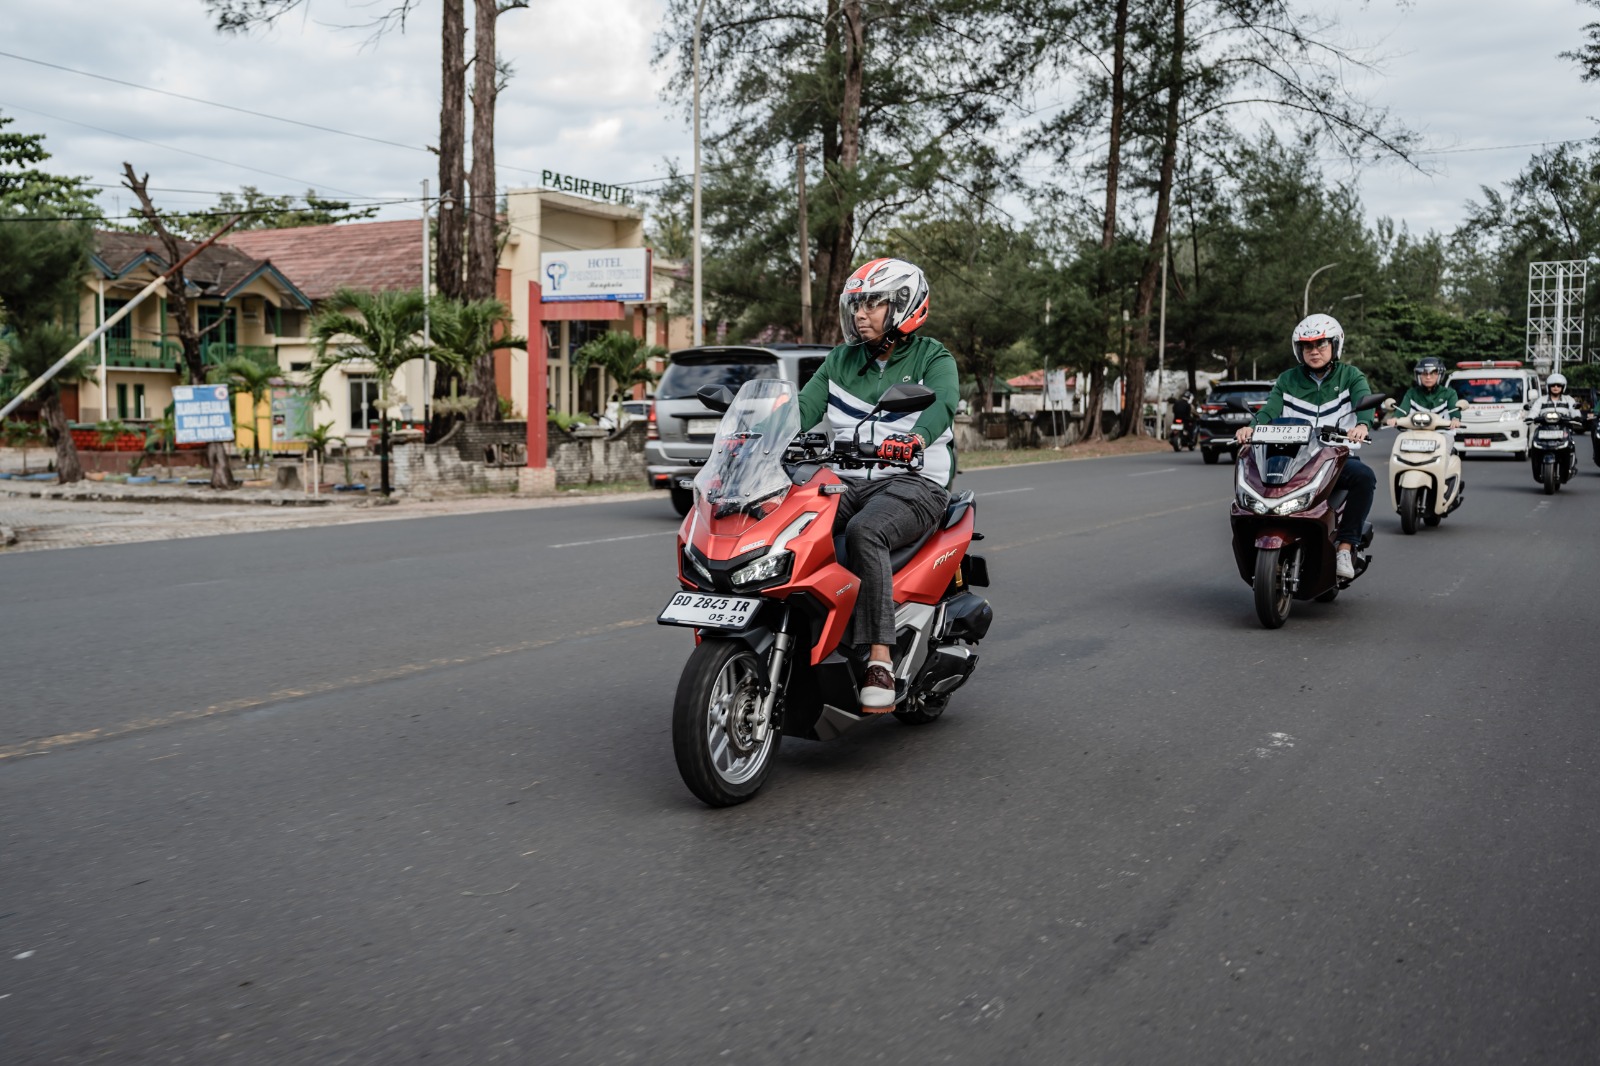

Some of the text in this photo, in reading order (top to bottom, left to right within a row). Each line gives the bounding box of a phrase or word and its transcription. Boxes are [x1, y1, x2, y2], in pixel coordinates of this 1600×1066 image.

[542, 169, 590, 195] PASIR
[587, 257, 623, 268] HOTEL
[672, 595, 750, 612] BD 2845 IR
